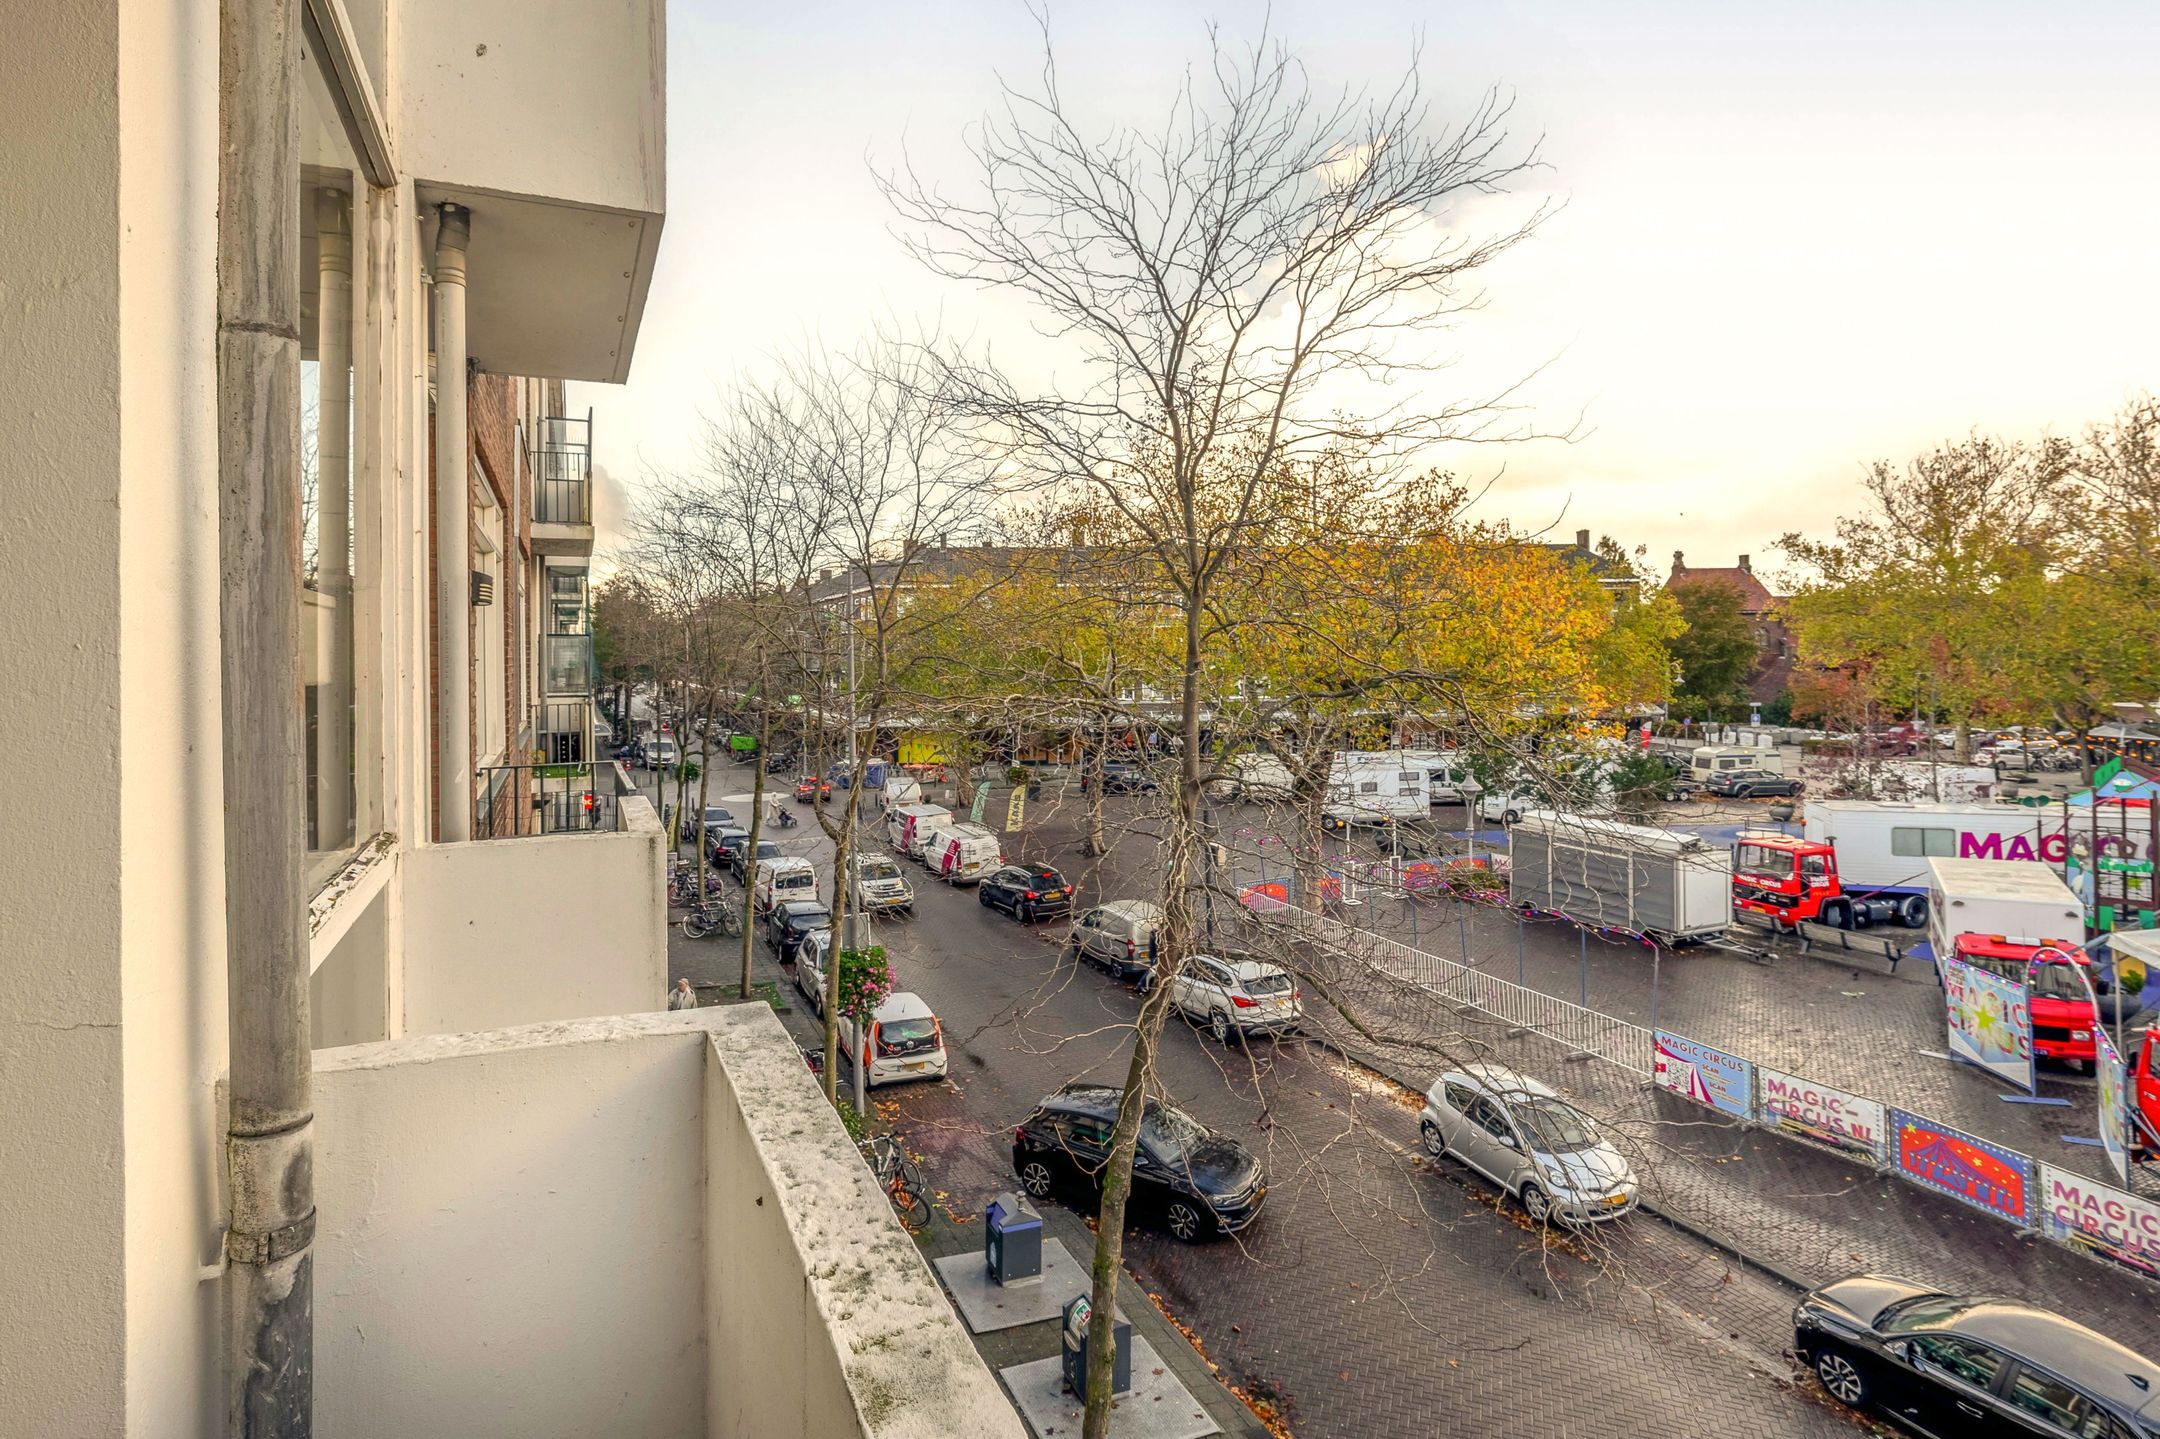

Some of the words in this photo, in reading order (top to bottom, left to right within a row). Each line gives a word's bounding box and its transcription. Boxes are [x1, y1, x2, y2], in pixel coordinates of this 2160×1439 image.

[1960, 831, 2126, 863] MAGC
[1661, 1035, 1698, 1057] MAGIC
[1703, 1051, 1744, 1073] CIRCUS
[2053, 1180, 2159, 1236] MAGIC
